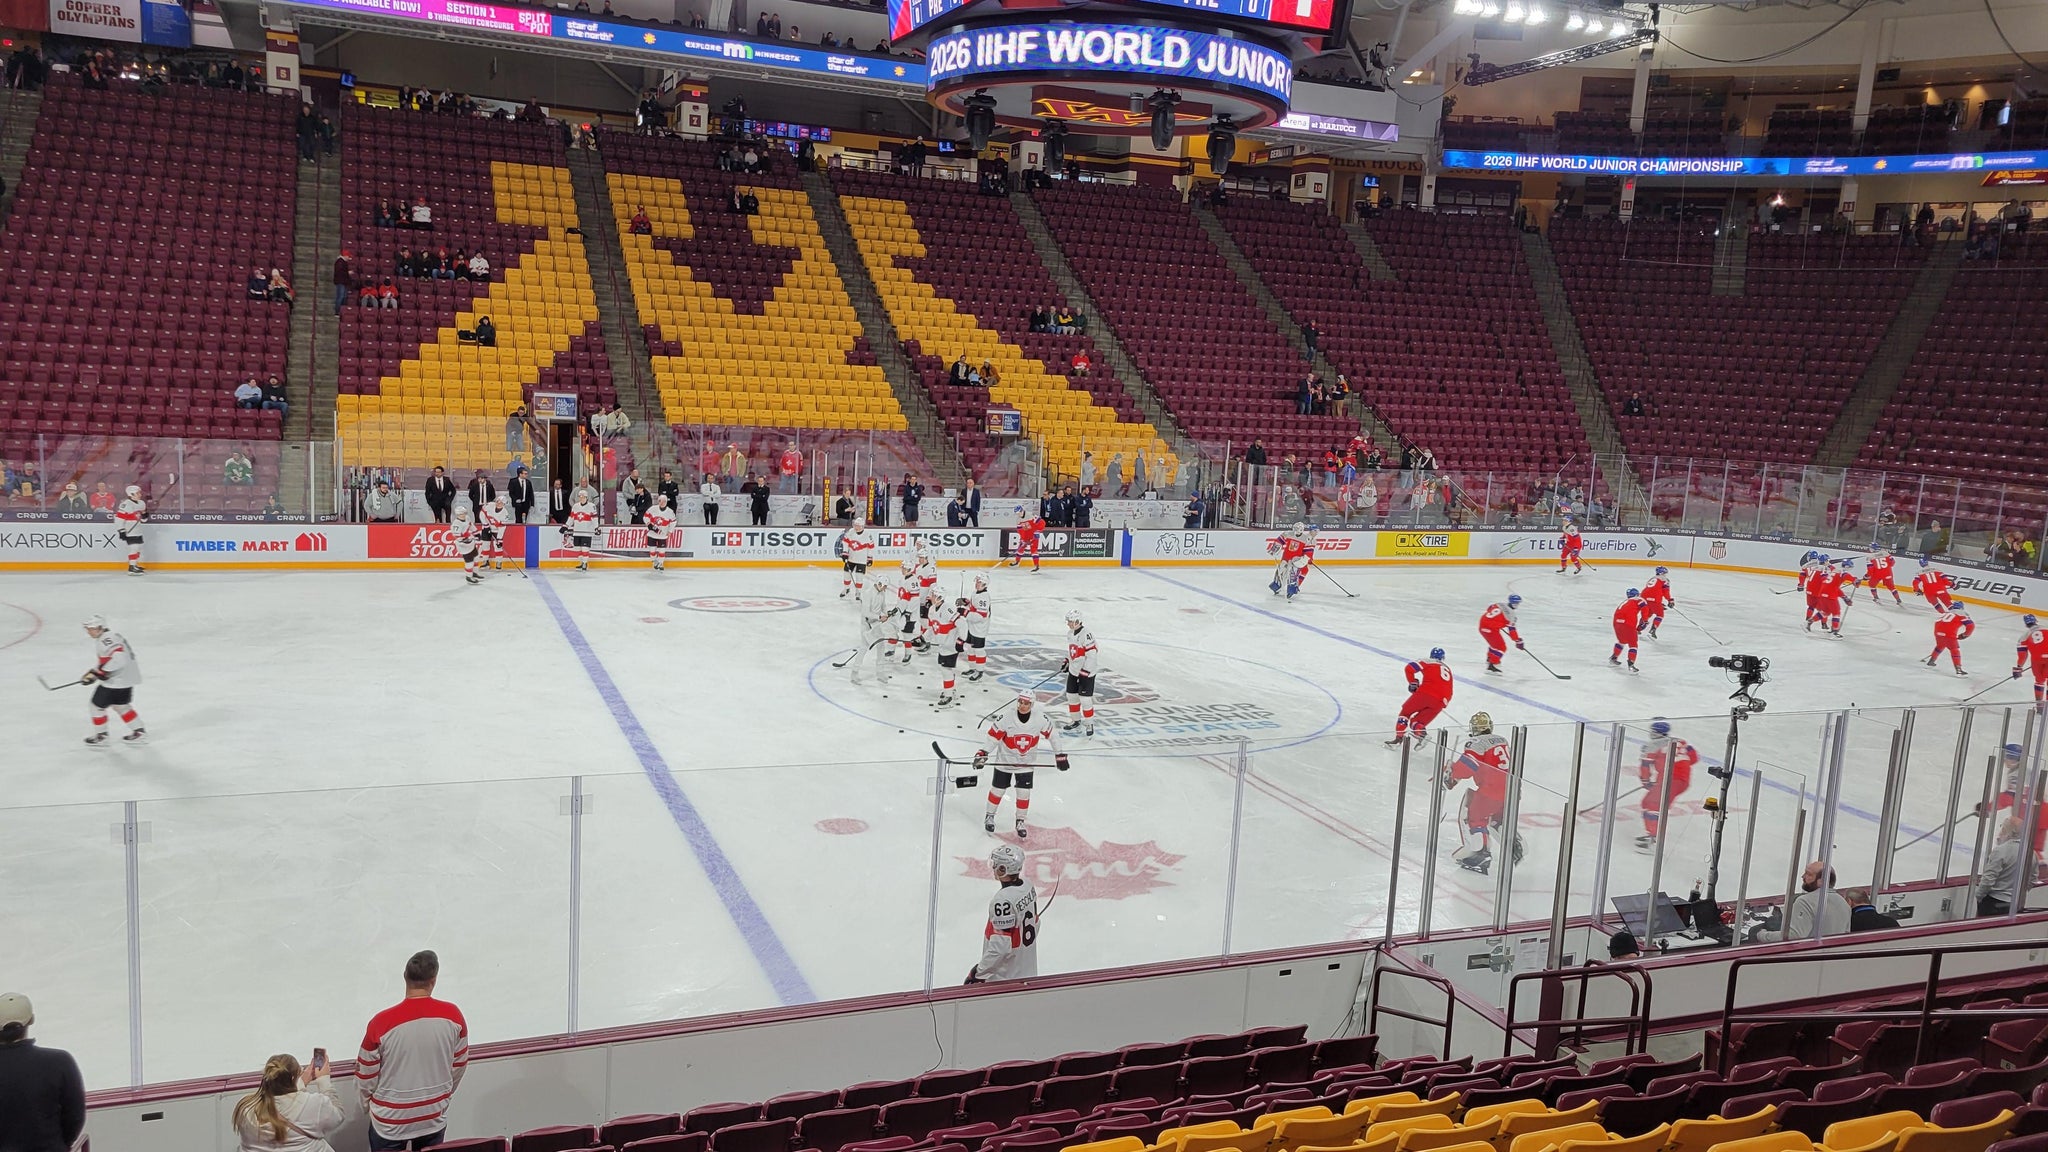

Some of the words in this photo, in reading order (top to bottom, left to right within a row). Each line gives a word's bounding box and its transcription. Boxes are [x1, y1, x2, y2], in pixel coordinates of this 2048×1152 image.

[66, 0, 121, 16] GOPHER
[393, 0, 422, 14] NOW!
[446, 2, 487, 18] SECTION
[489, 8, 496, 19] 1
[57, 10, 135, 29] OLYMPIANS
[476, 19, 515, 31] CONCOURSE
[518, 12, 546, 25] SPLIT
[566, 21, 586, 30] star
[587, 23, 598, 31] of
[530, 22, 550, 34] POT
[567, 28, 583, 37] the
[827, 56, 844, 64] star
[845, 57, 855, 65] of
[827, 63, 842, 71] the
[929, 37, 971, 77] 2026
[976, 31, 1041, 67] IIHF
[1046, 29, 1191, 70] WORLD
[1197, 41, 1288, 92] JUNIOR
[1319, 122, 1356, 133] MARIUCCI
[1483, 155, 1513, 168] 2026
[1515, 156, 1540, 168] IIHF
[1541, 157, 1587, 170] WORLD
[1589, 158, 1637, 172] JUNIOR
[1640, 160, 1743, 173] CHAMPIONSHIP
[1, 533, 117, 549] KARBON-X
[176, 540, 236, 552] TIMBER
[242, 541, 289, 552] MART
[607, 528, 648, 549] ALBERTA
[746, 532, 827, 547] TISSOT
[1008, 532, 1068, 550] BMP
[1183, 533, 1215, 548] BFL
[1396, 533, 1425, 548] OK
[1425, 535, 1448, 546] TIRE
[1583, 540, 1637, 551] PureFibre
[1875, 557, 1888, 570] 15
[1925, 572, 1938, 584] 11
[1132, 702, 1264, 717] JUNIOR
[1160, 719, 1282, 734] STATES
[1100, 733, 1254, 748] Minnesota
[994, 901, 1011, 917] 62
